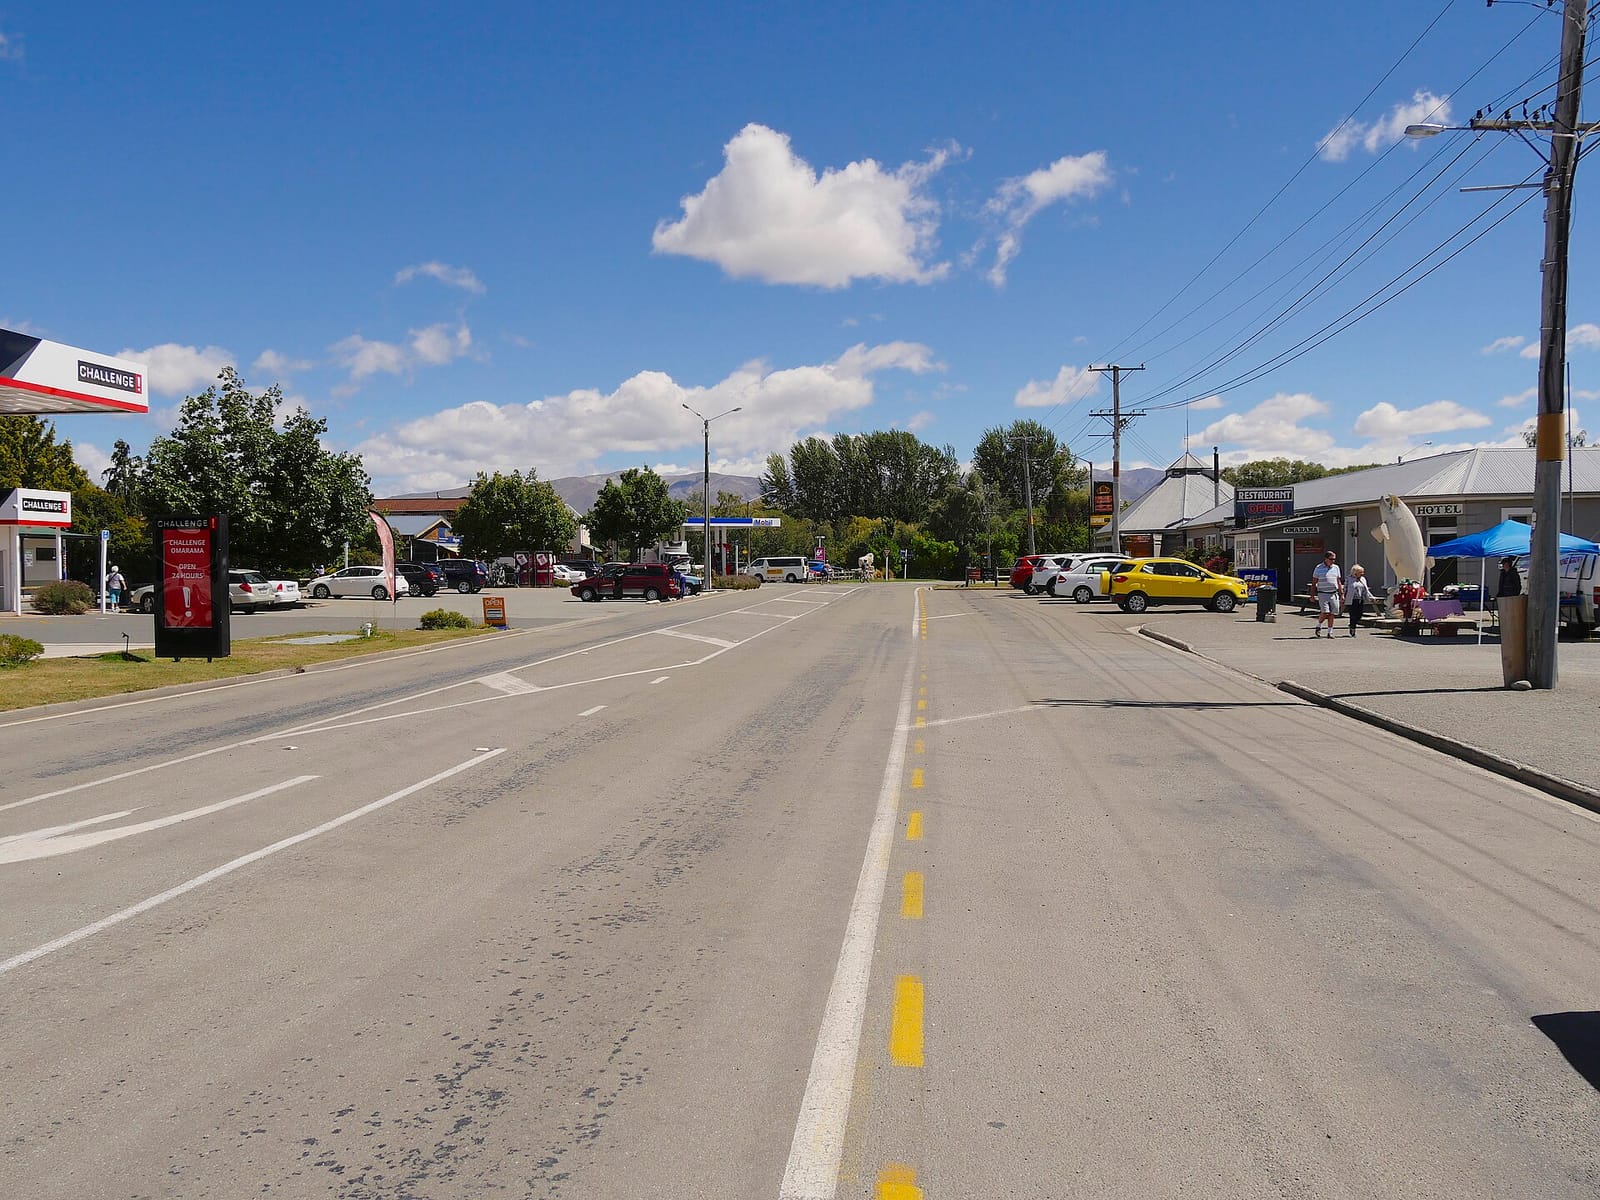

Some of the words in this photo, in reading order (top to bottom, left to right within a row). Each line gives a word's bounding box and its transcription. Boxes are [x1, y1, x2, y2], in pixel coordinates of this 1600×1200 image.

[1238, 490, 1291, 500] RESTAURANT
[1247, 503, 1283, 514] OPEN
[1417, 504, 1462, 515] HOTEL
